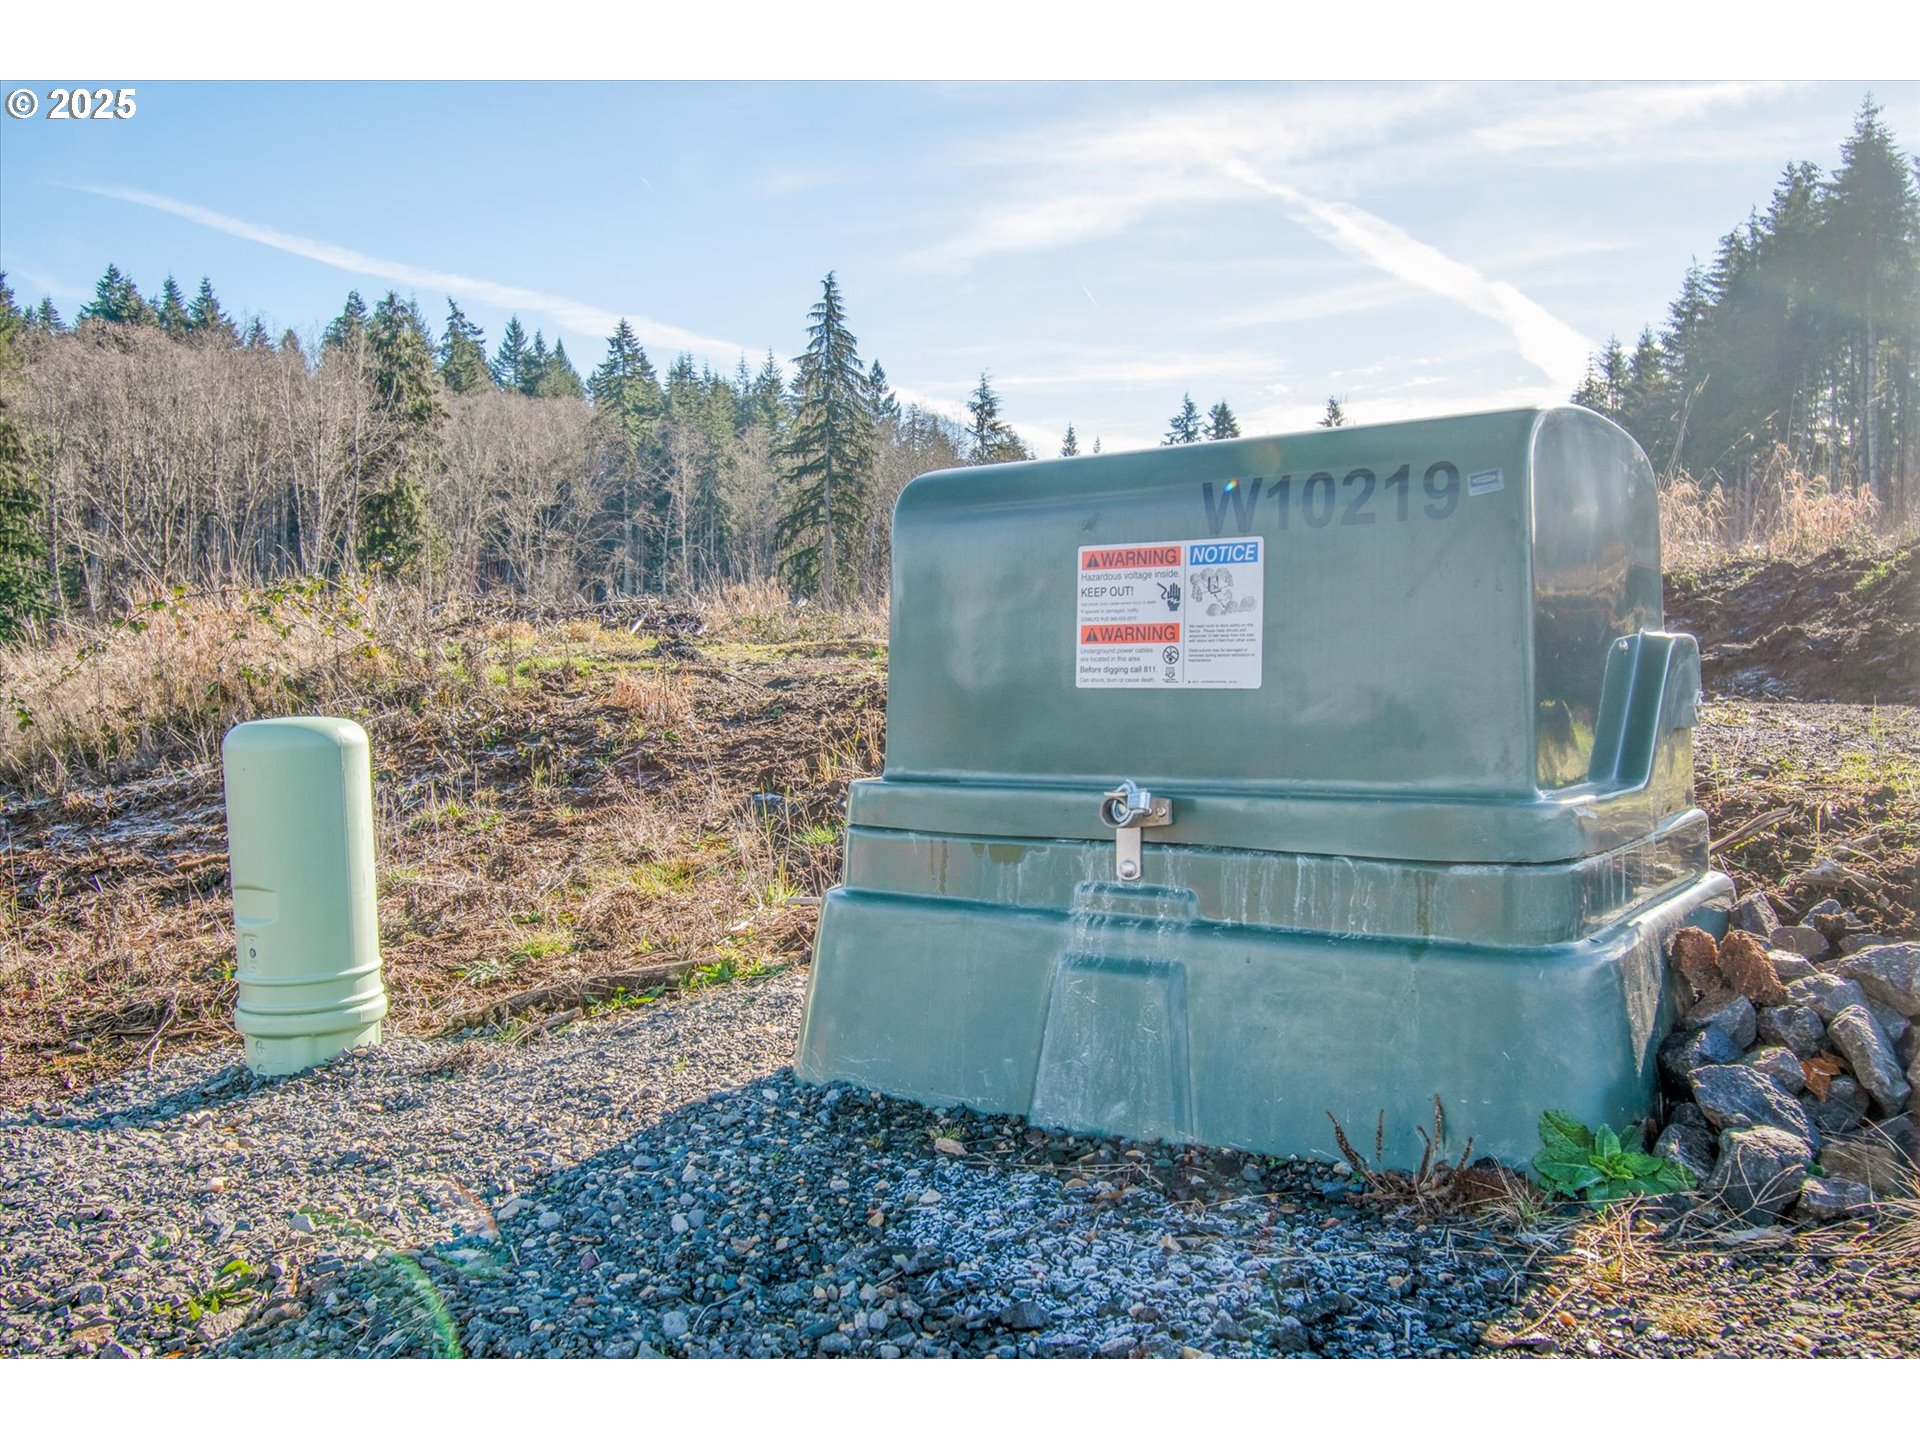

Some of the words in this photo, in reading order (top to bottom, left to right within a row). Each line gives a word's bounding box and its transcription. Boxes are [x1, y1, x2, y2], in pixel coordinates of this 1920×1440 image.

[1202, 460, 1460, 535] W10219
[1101, 549, 1177, 567] WARNING
[1192, 544, 1256, 563] NOTICE
[1081, 571, 1122, 581] Hazardous
[1124, 570, 1152, 581] voltage
[1081, 587, 1107, 598] KEEP
[1109, 586, 1134, 597] OUT!
[1100, 625, 1176, 641] WARNING
[1080, 647, 1115, 655] Underground
[1103, 666, 1128, 674] digging
